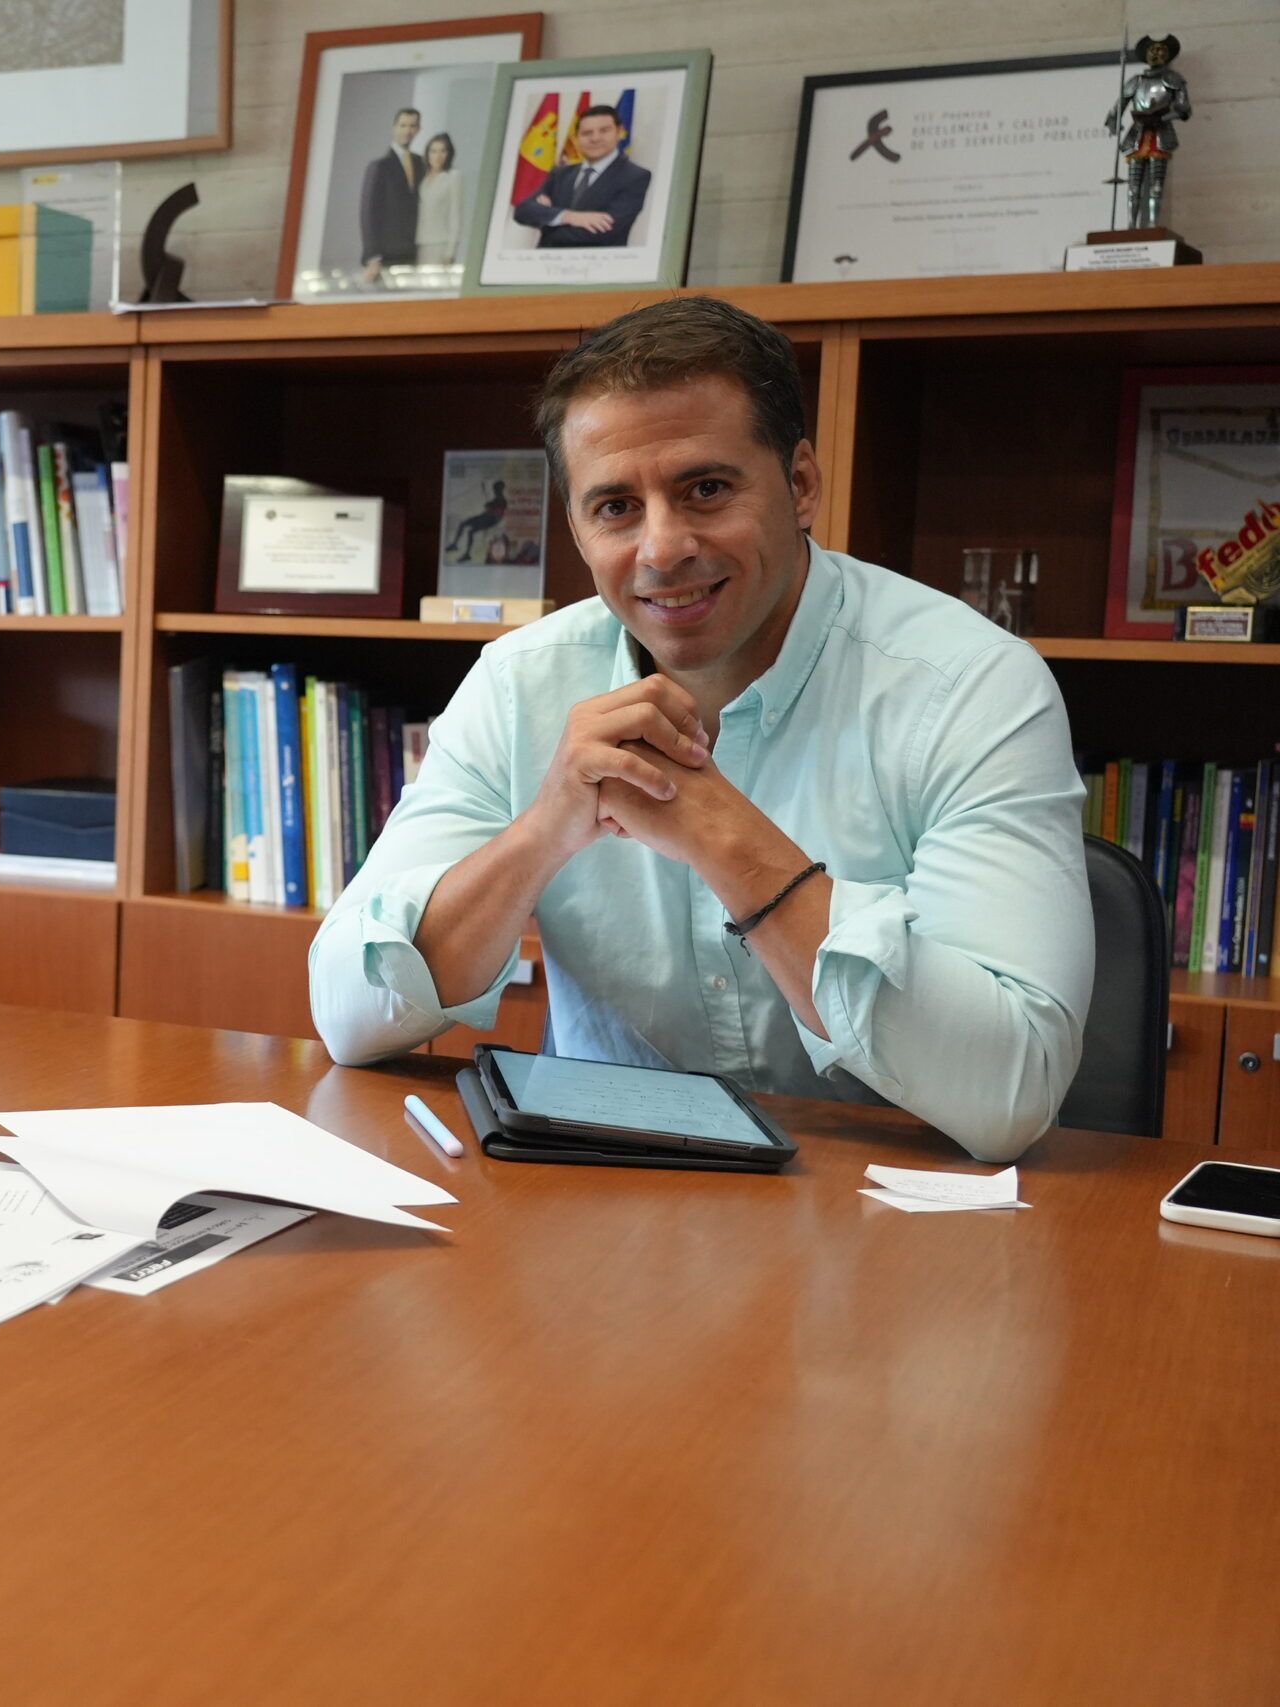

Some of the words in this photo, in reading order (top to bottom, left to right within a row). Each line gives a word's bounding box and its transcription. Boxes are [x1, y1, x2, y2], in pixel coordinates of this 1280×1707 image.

[911, 121, 989, 137] EXCELENCIA
[1012, 116, 1070, 130] CALIDAD
[933, 138, 956, 149] LOS
[965, 132, 1036, 147] SERVICIOS
